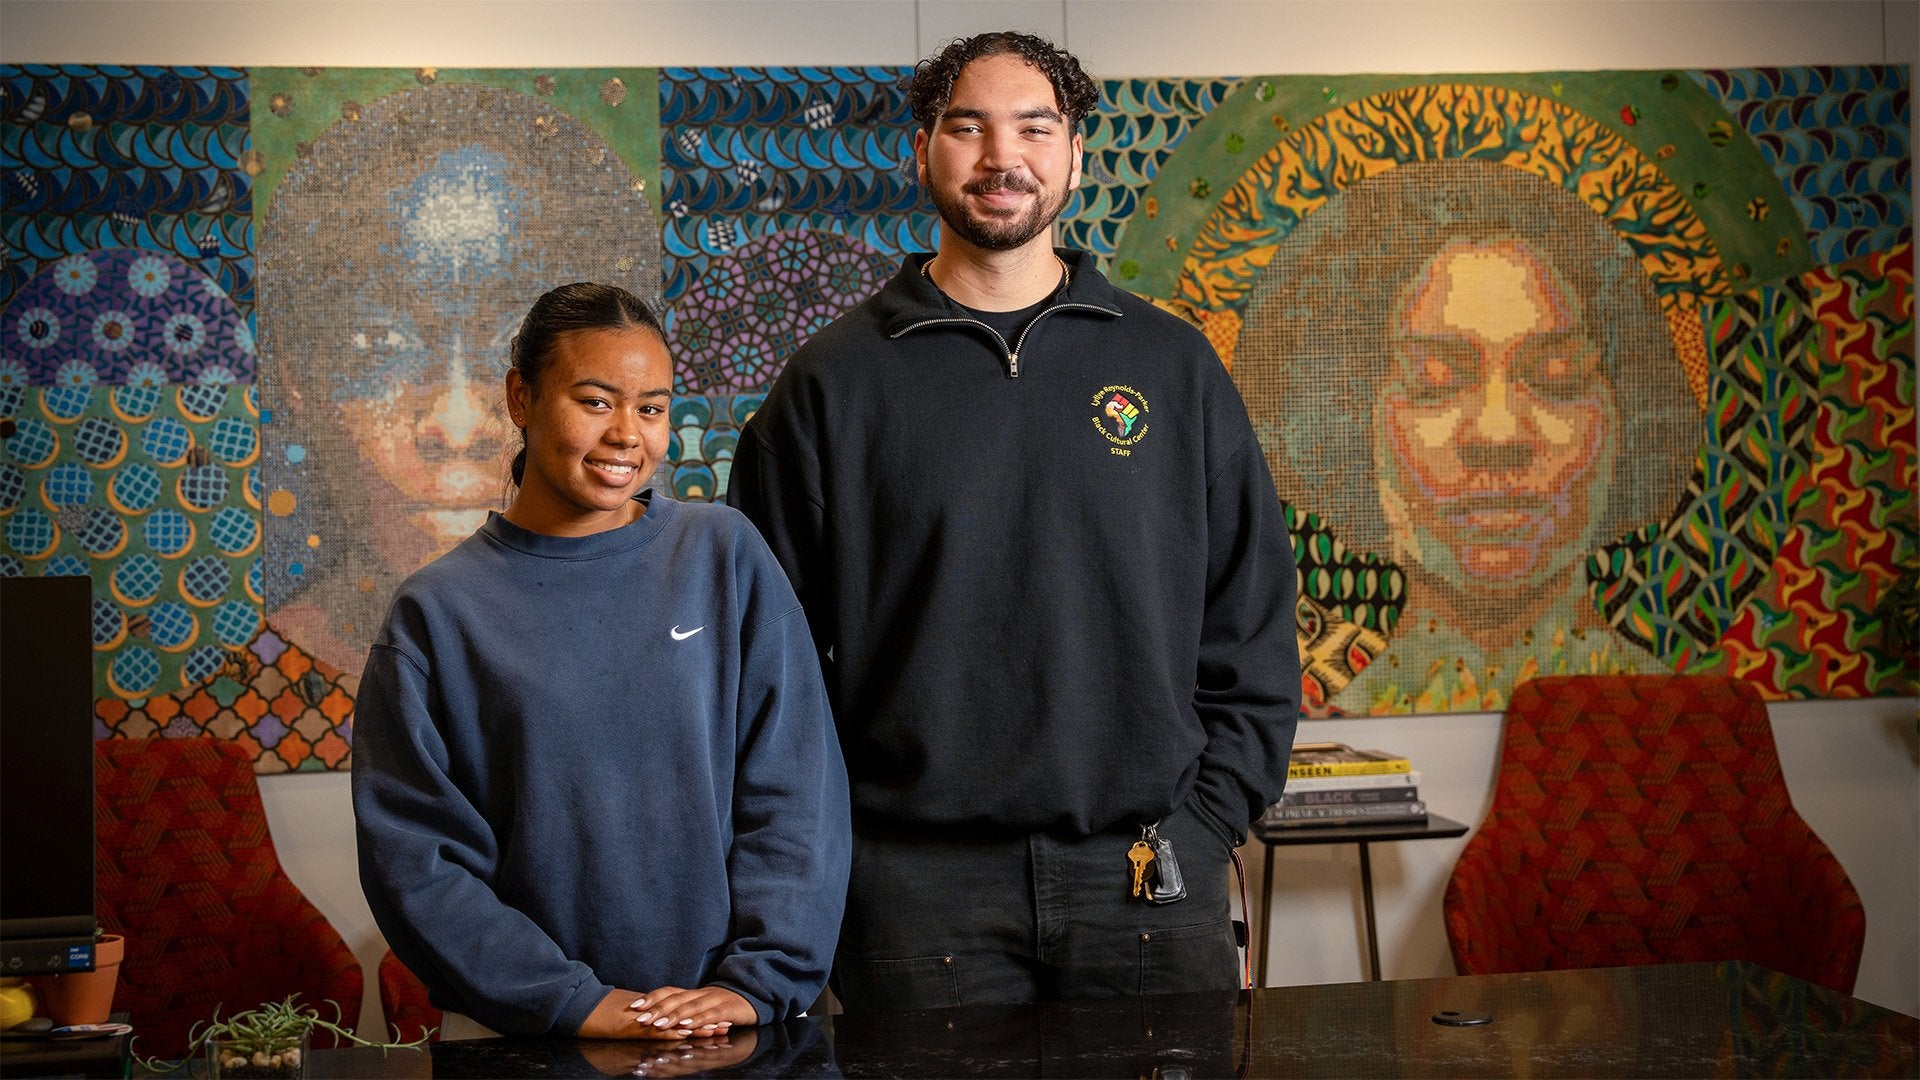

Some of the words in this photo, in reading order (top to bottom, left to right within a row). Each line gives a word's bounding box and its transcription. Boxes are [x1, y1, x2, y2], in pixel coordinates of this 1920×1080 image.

[1103, 385, 1150, 413] Reynolds-Parker
[1092, 416, 1107, 435] Black
[1106, 433, 1133, 445] Cultural
[1132, 423, 1150, 443] Center
[1110, 447, 1131, 457] STAFF
[1289, 767, 1332, 777] NSEEN
[1304, 791, 1353, 804] BLACK
